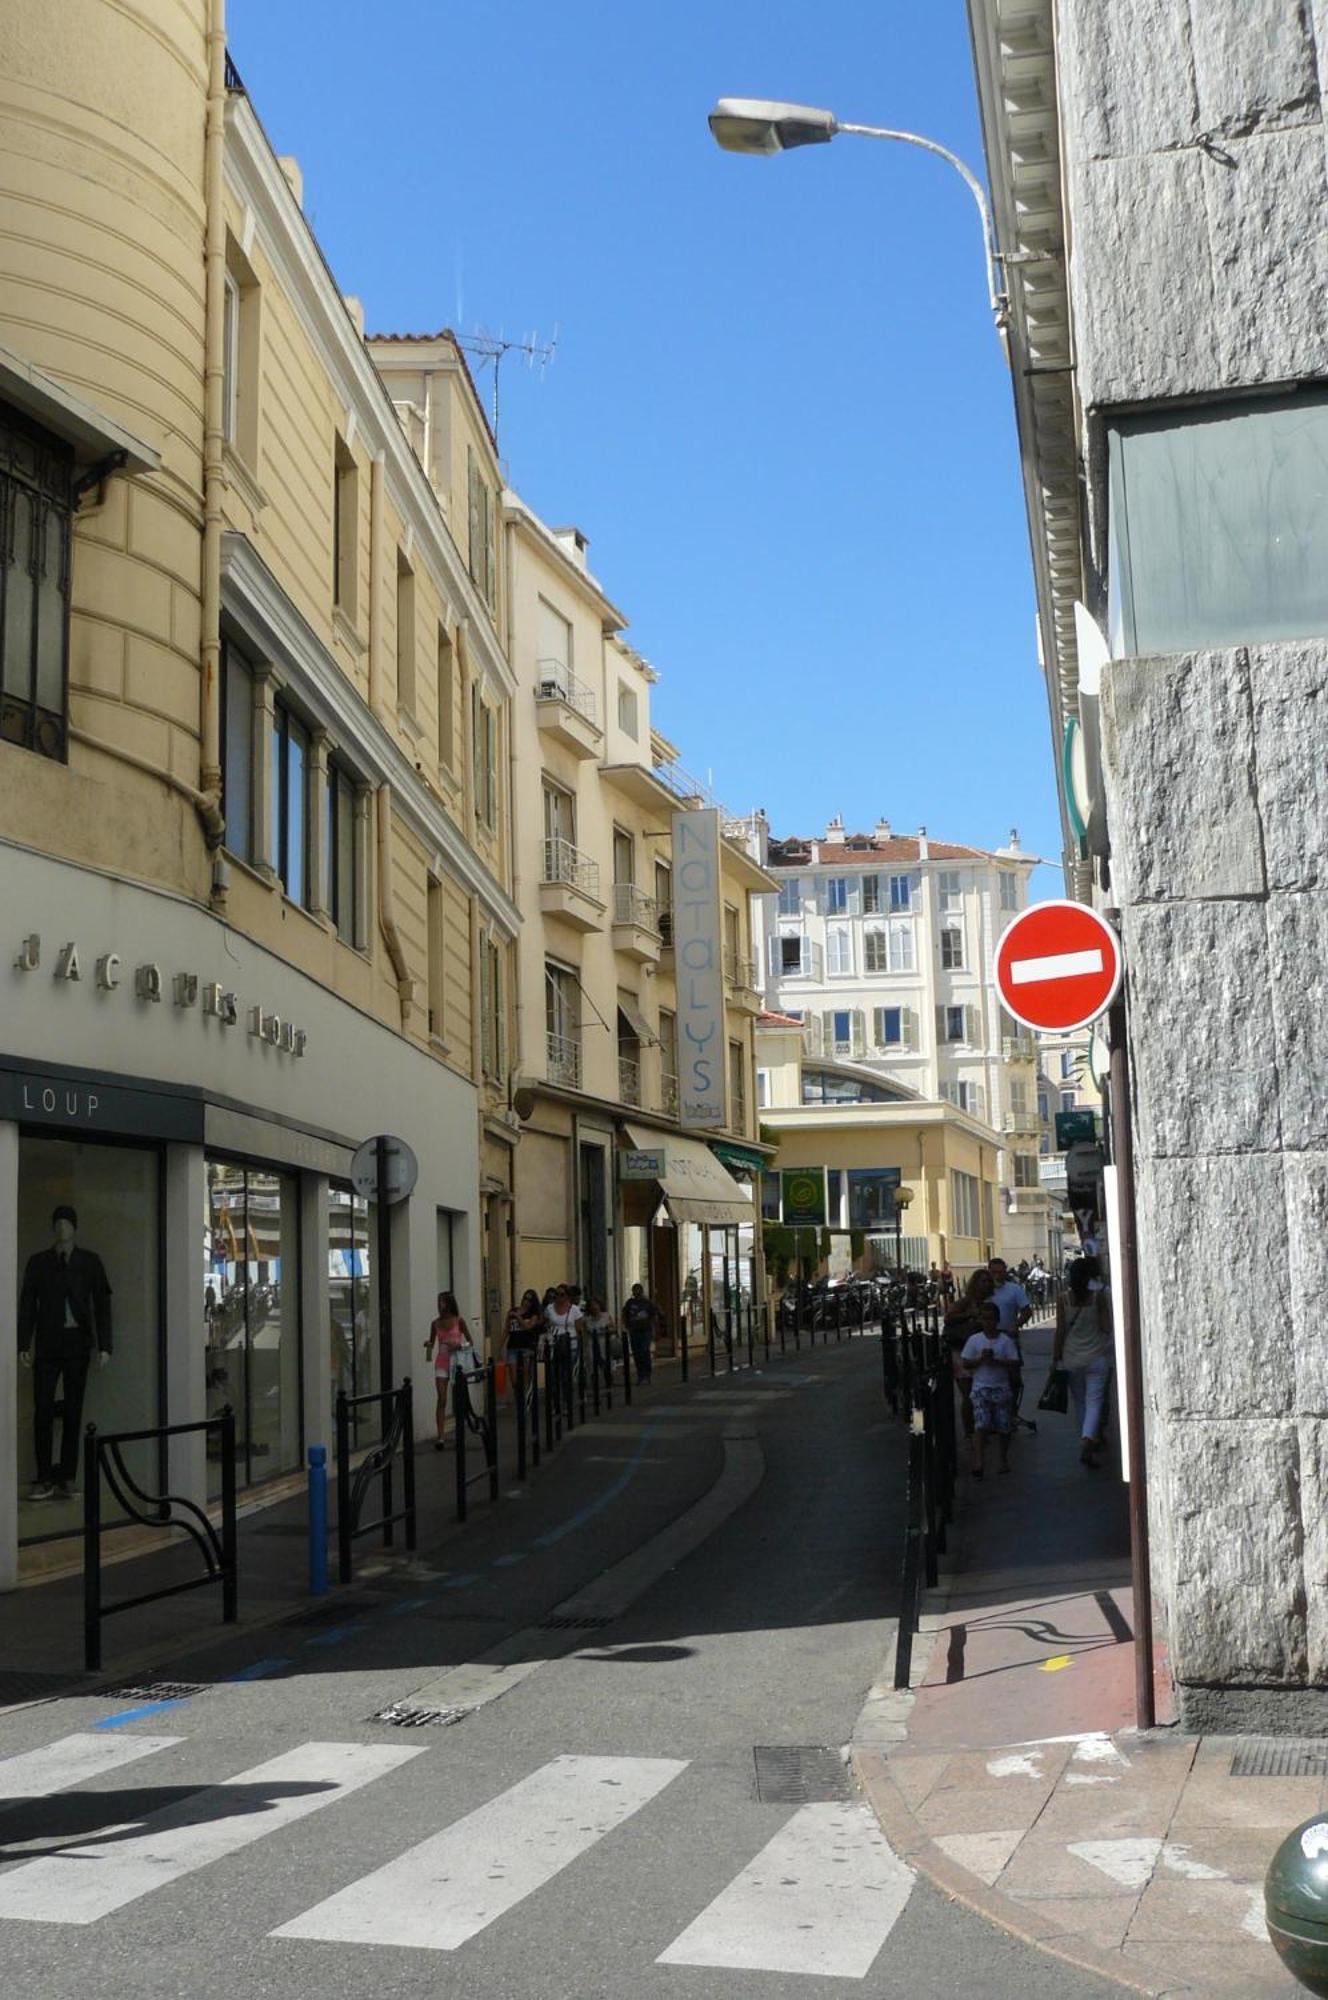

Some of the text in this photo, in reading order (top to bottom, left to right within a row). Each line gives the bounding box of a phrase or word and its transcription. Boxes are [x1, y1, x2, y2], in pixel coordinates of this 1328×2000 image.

[20, 934, 306, 1057] JACQUES LOUP
[23, 1085, 99, 1117] LOUP
